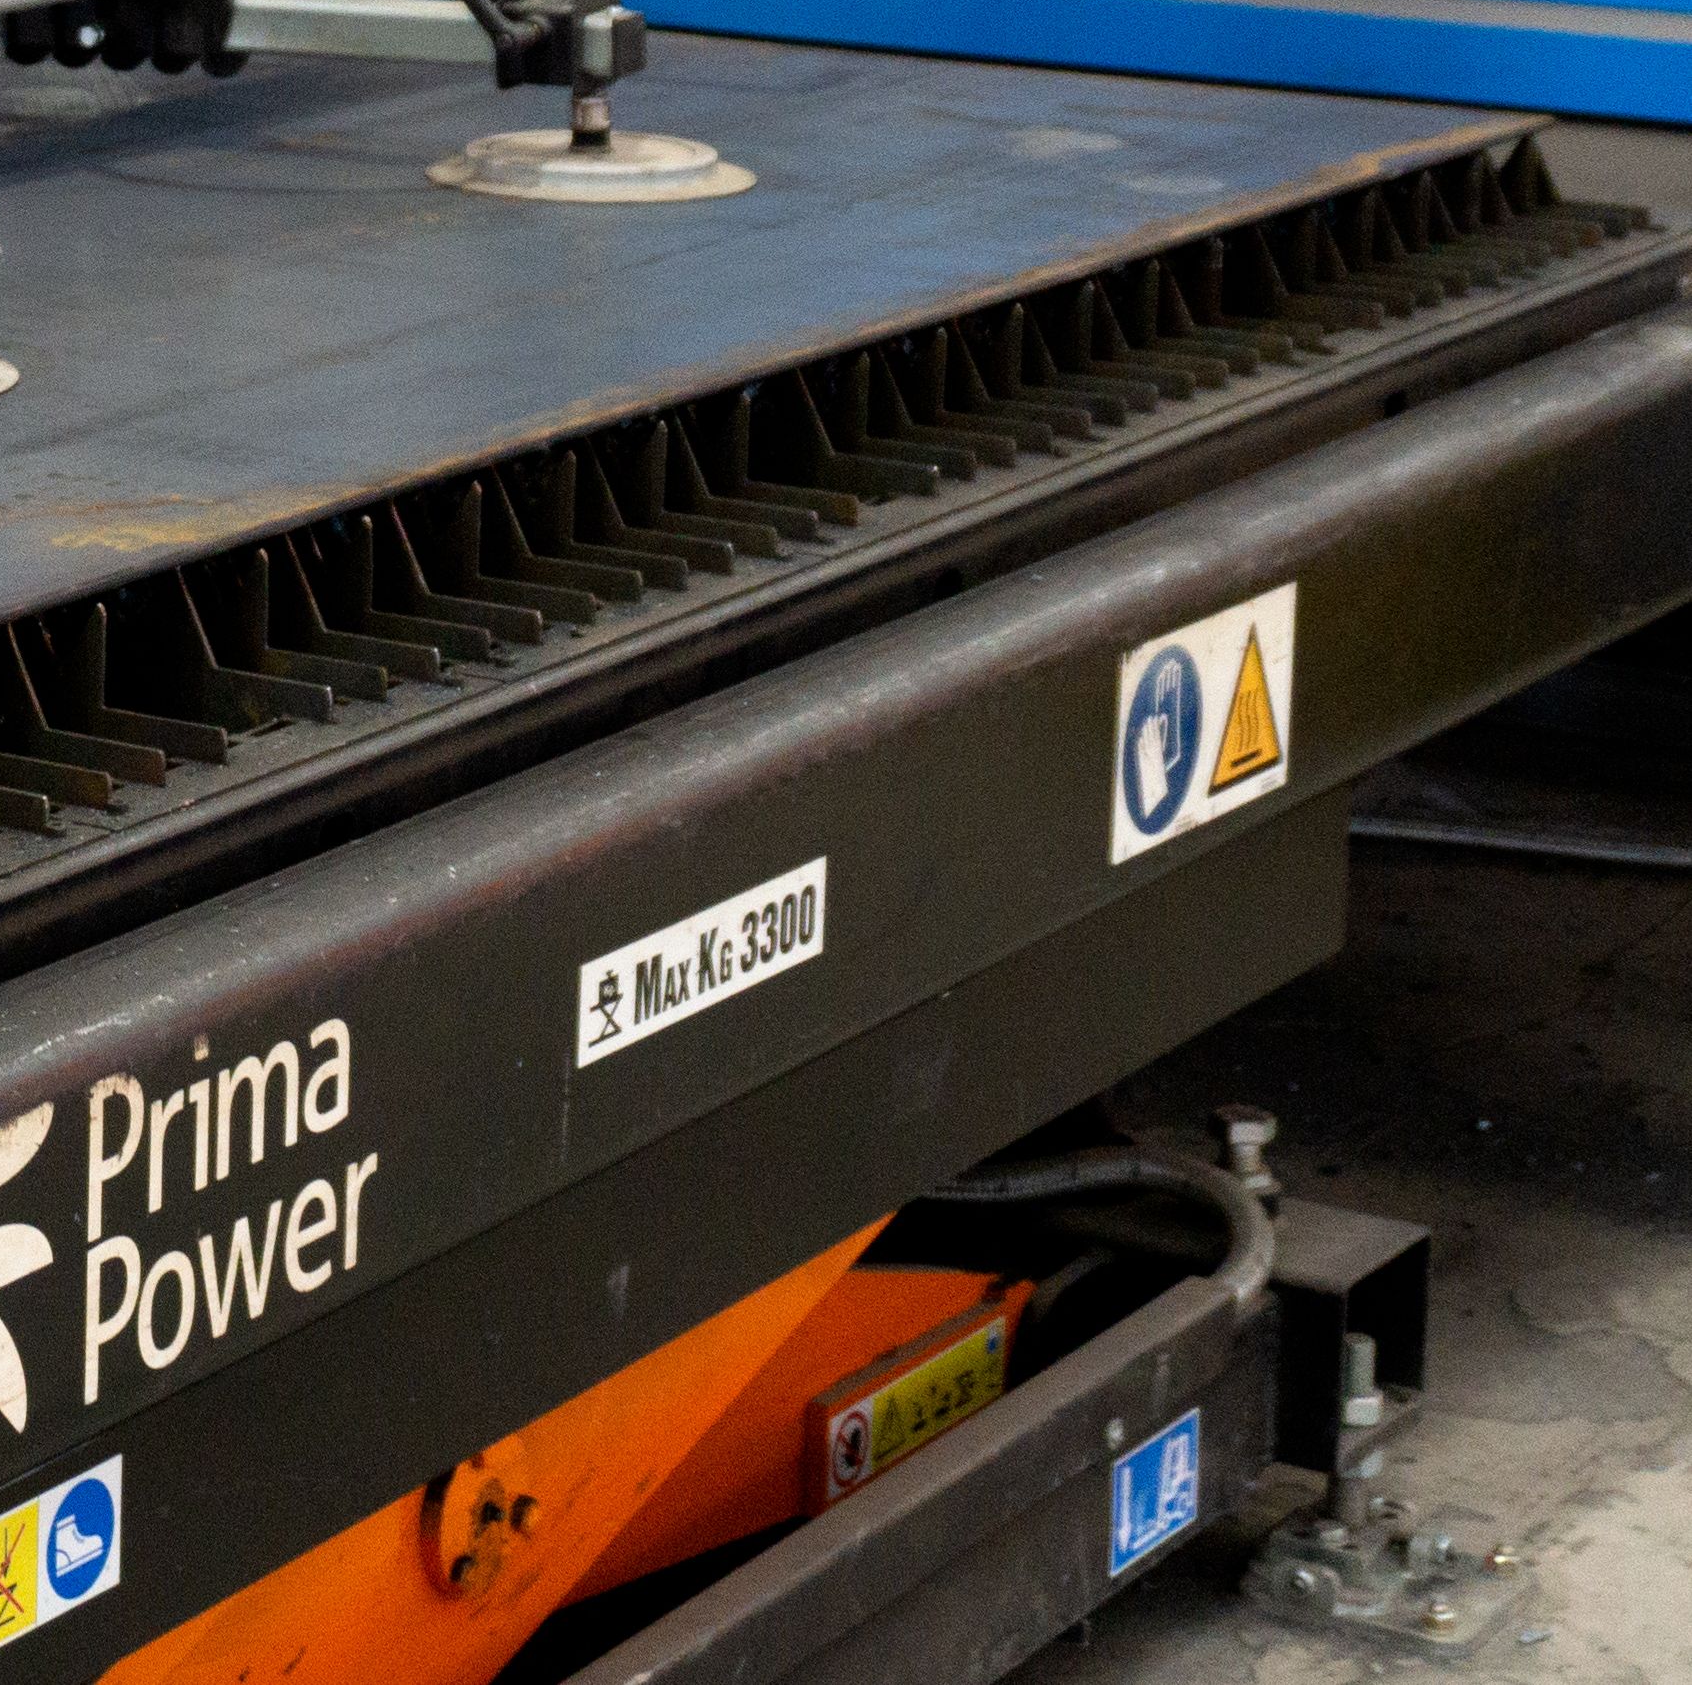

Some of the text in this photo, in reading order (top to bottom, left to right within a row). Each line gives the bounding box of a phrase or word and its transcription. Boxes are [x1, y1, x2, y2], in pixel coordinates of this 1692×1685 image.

[740, 883, 817, 974] 3300
[88, 1018, 351, 1243] Prima
[83, 1152, 379, 1406] Power
